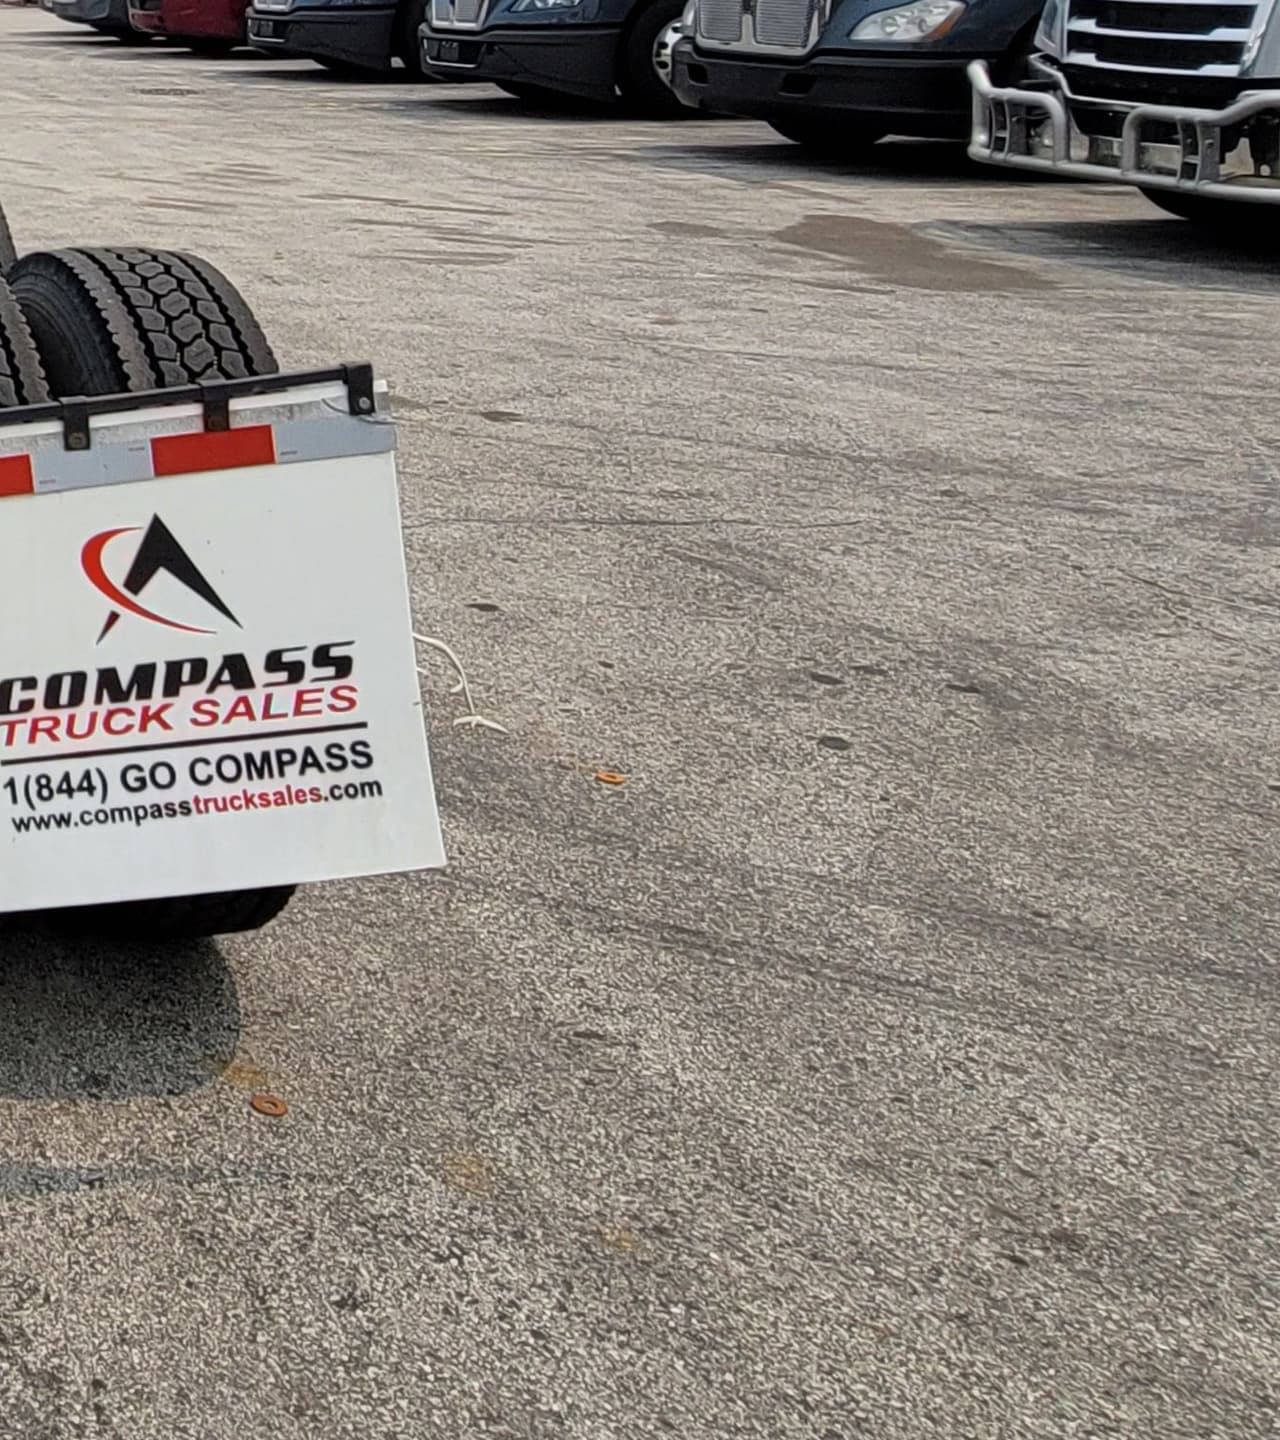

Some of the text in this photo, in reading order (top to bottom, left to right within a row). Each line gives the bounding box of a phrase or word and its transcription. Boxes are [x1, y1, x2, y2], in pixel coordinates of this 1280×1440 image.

[190, 684, 358, 726] SALES
[3, 741, 374, 807] 1(844) GO COMPASS
[12, 776, 383, 833] www.compasstrucksales.com
